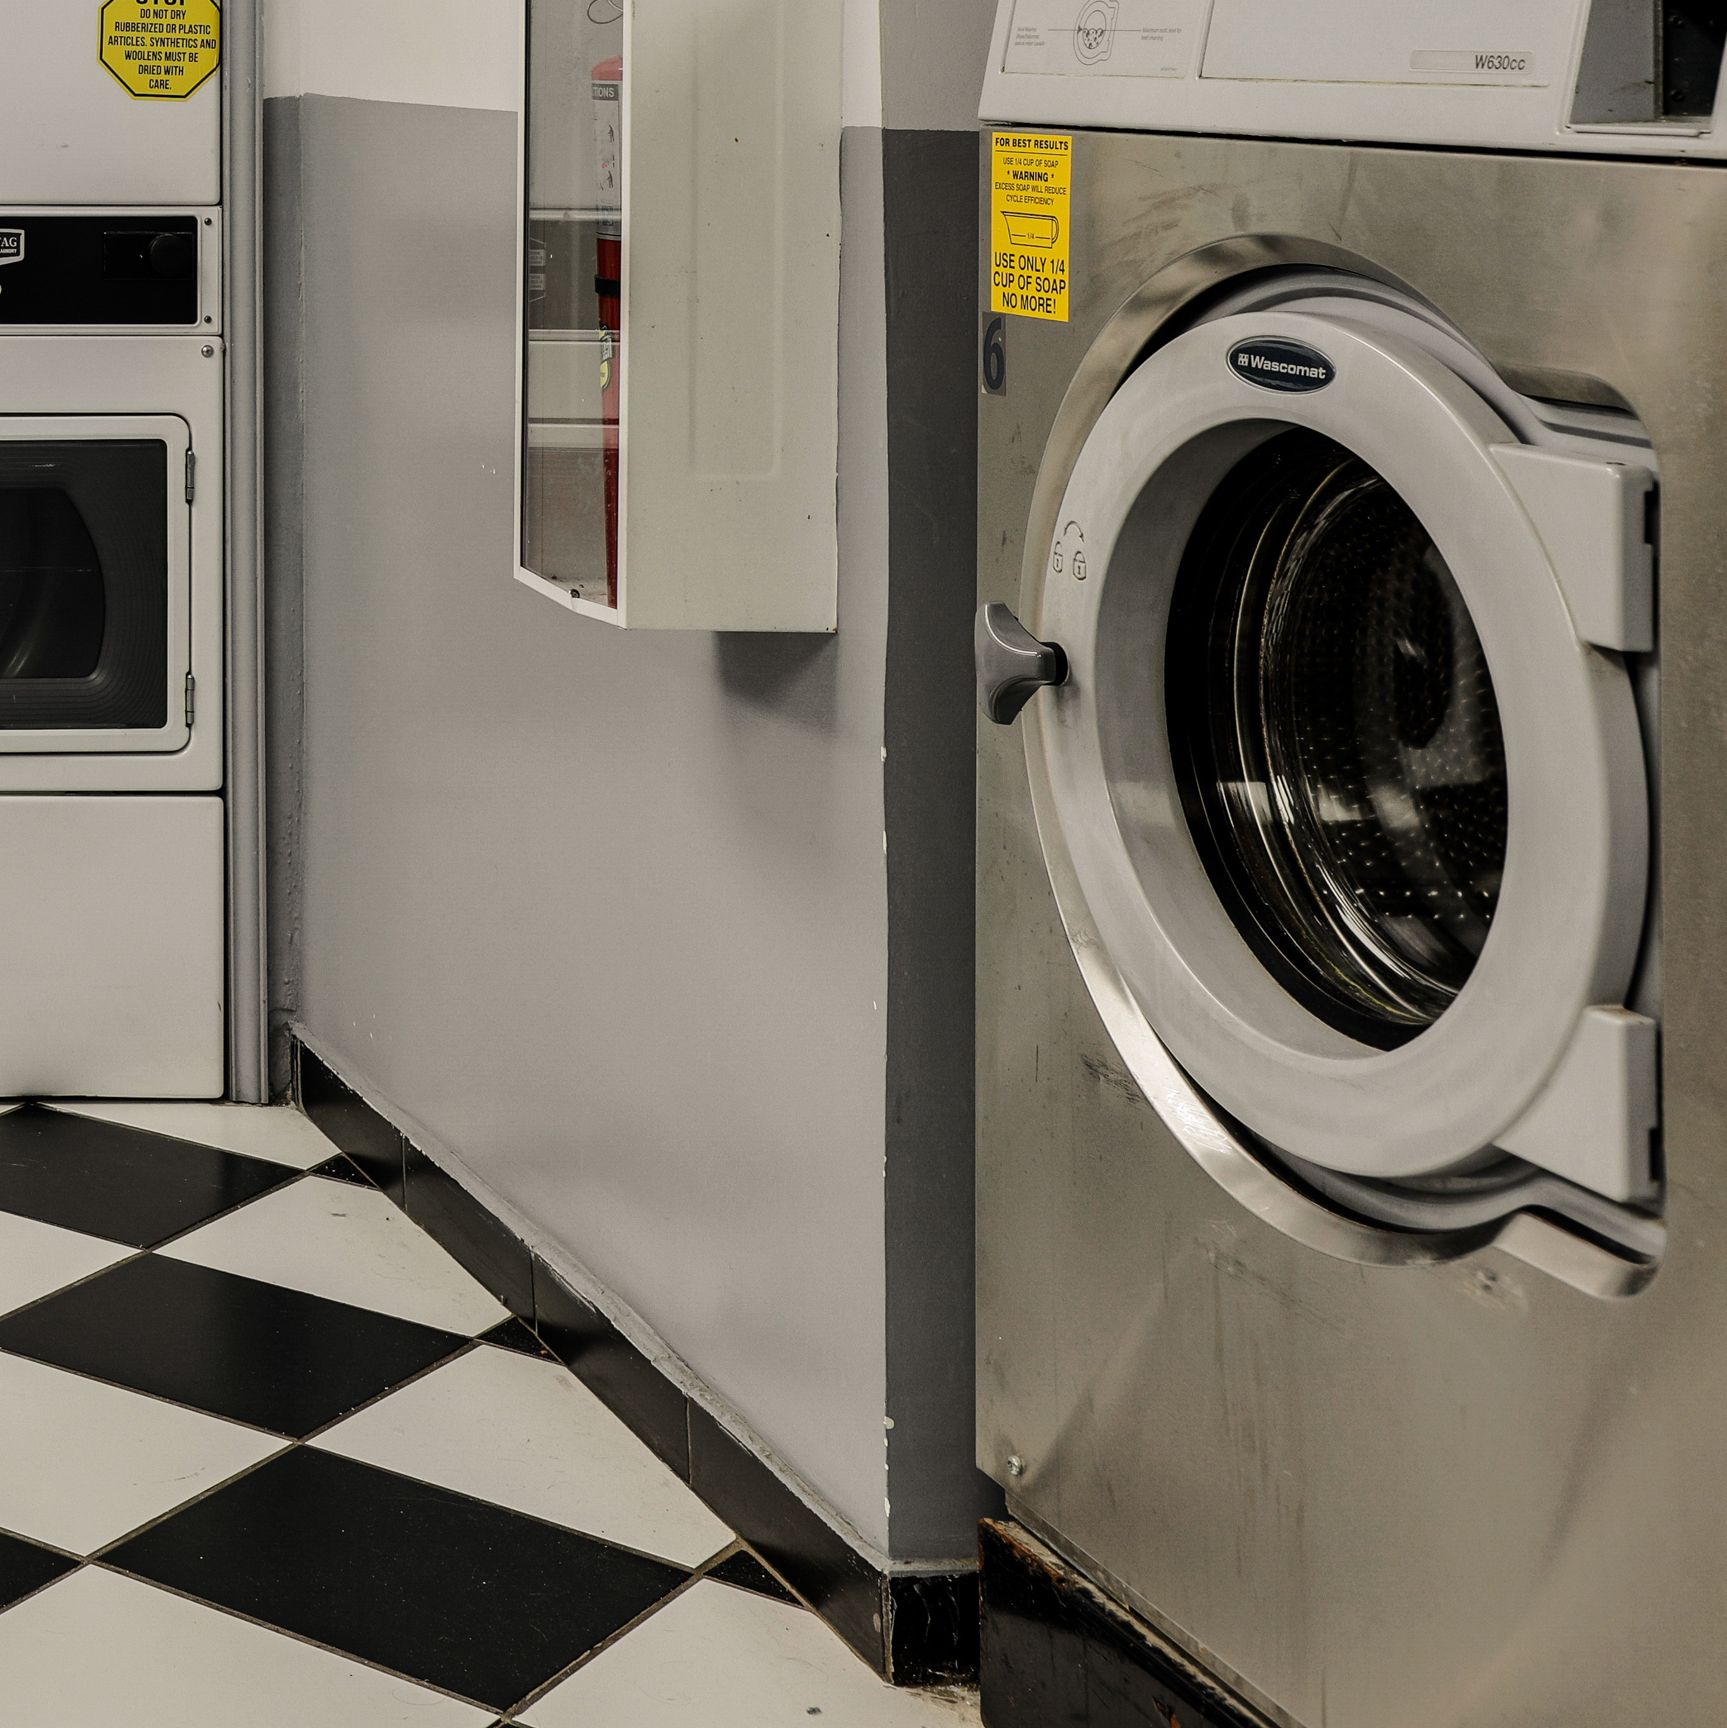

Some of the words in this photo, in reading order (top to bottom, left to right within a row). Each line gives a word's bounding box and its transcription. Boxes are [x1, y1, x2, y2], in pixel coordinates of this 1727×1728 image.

[139, 8, 152, 20] DO
[152, 8, 170, 20] NOT
[170, 9, 187, 21] DRY
[114, 21, 165, 34] RUBBERIZED
[165, 23, 177, 35] OR
[178, 23, 212, 36] PLASTIC
[107, 35, 148, 48] ARTICLES.
[149, 36, 199, 49] SYNTHETICS
[199, 38, 217, 50] AND
[124, 49, 163, 62] WOOLENS
[164, 51, 187, 63] MUST
[188, 51, 200, 63] BE
[1475, 54, 1526, 71] W630cc
[138, 64, 163, 76] DRIED
[163, 65, 185, 77] WITH
[148, 78, 172, 90] CARE.
[995, 137, 1011, 147] FOR
[1012, 138, 1032, 148] BEST
[1033, 139, 1069, 151] RESULTS
[1012, 170, 1049, 182] WARNING
[994, 251, 1016, 270] USE
[1018, 254, 1047, 273] ONLY
[1050, 258, 1066, 276] 1/4
[993, 271, 1015, 289] CUP
[1017, 274, 1033, 291] OF
[1034, 276, 1067, 295] SOAP
[1002, 291, 1018, 309] NO
[1020, 294, 1057, 315] MORE!
[983, 317, 1005, 391] 6
[1250, 354, 1327, 379] Wascomat
